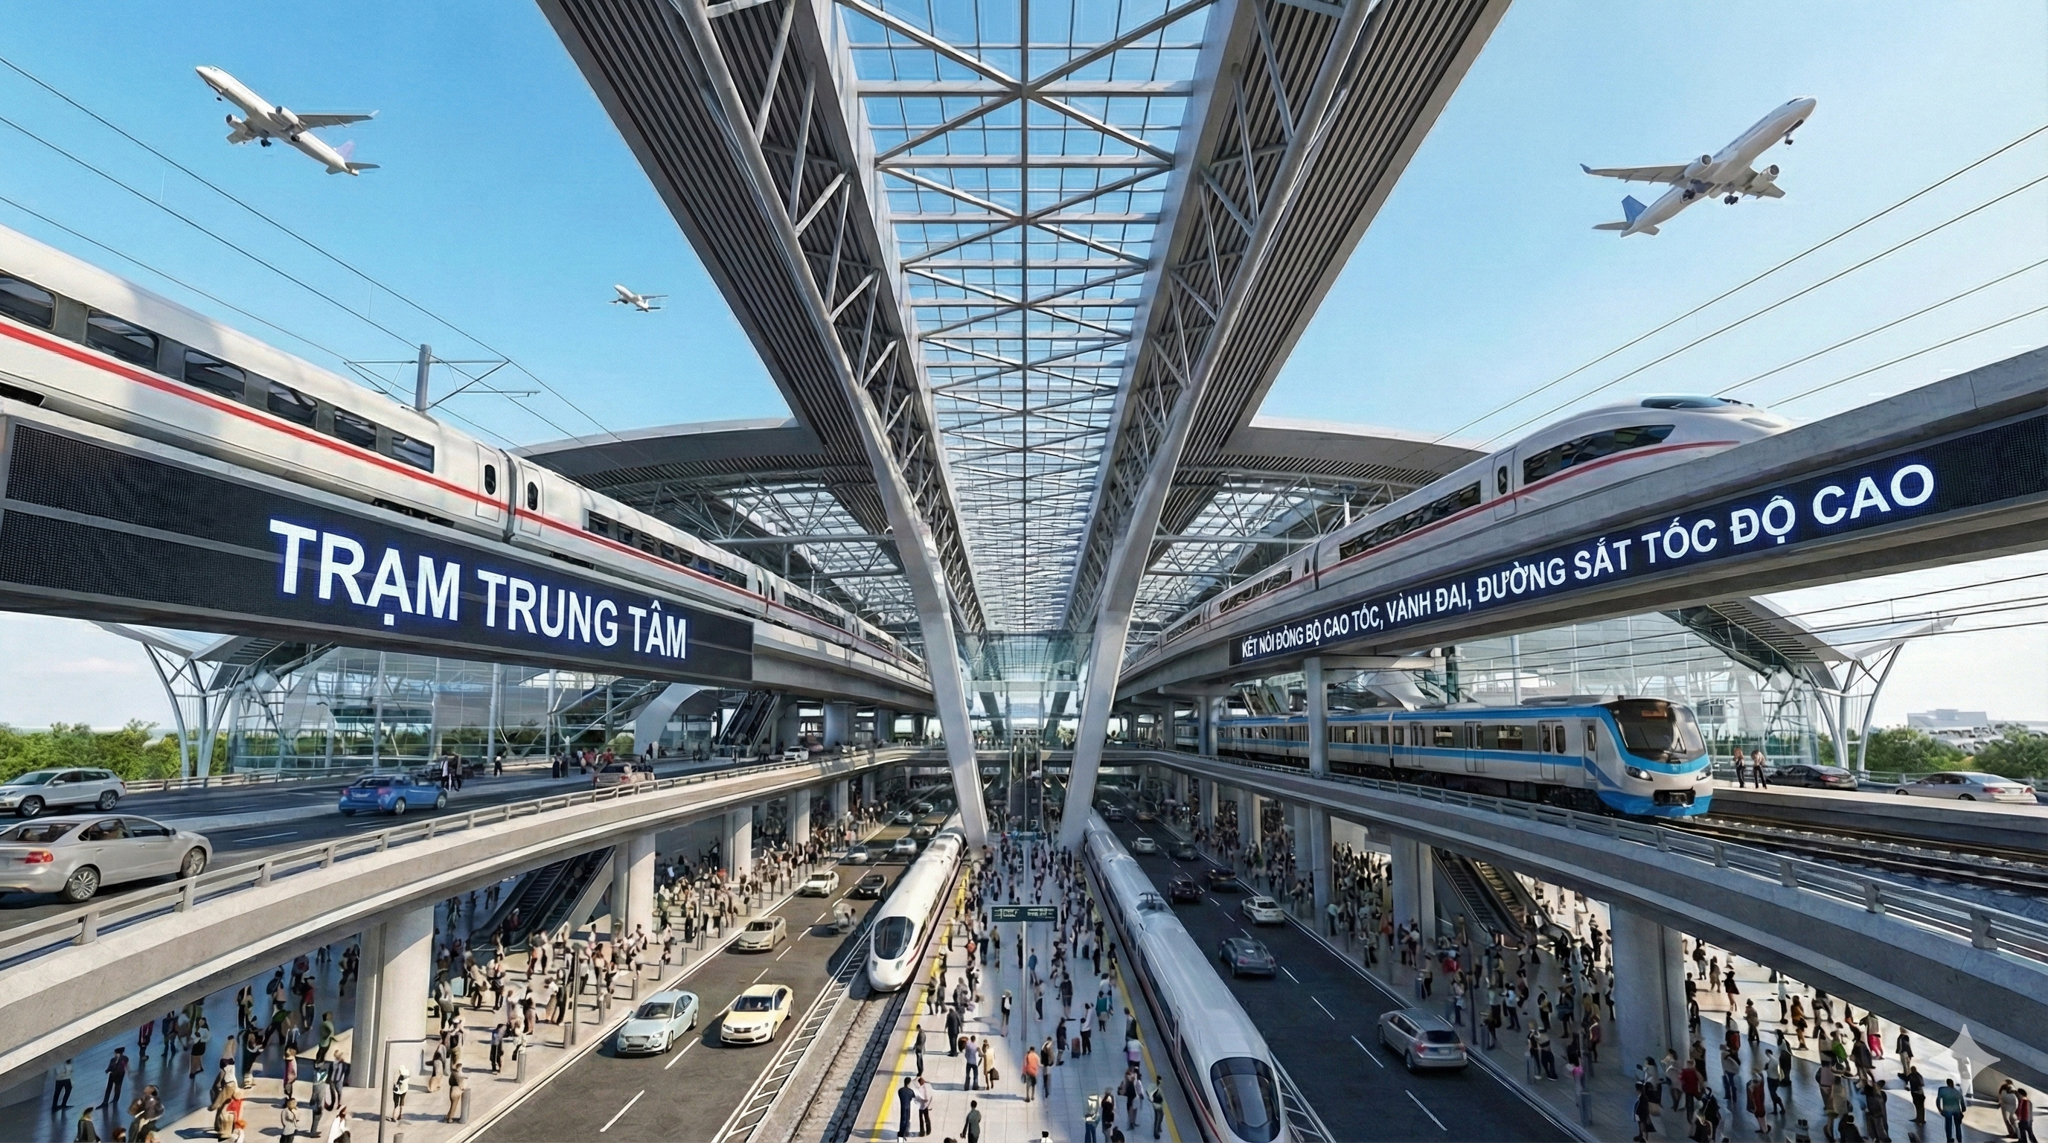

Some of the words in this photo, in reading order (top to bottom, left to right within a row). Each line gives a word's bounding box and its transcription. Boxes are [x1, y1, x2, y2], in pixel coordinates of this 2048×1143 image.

[269, 518, 461, 626] TRẠM
[477, 570, 619, 647] TRUNG
[628, 599, 687, 660] TÂM
[1323, 614, 1349, 638] CAO
[1386, 591, 1431, 623] VÀNH
[1435, 582, 1472, 610] ĐAI,
[1476, 557, 1566, 603] ĐƯỜNG
[1574, 536, 1632, 580] SẮT
[1641, 517, 1718, 564] TỐC
[1729, 495, 1796, 545] ĐỘ
[1812, 464, 1934, 526] CAO
